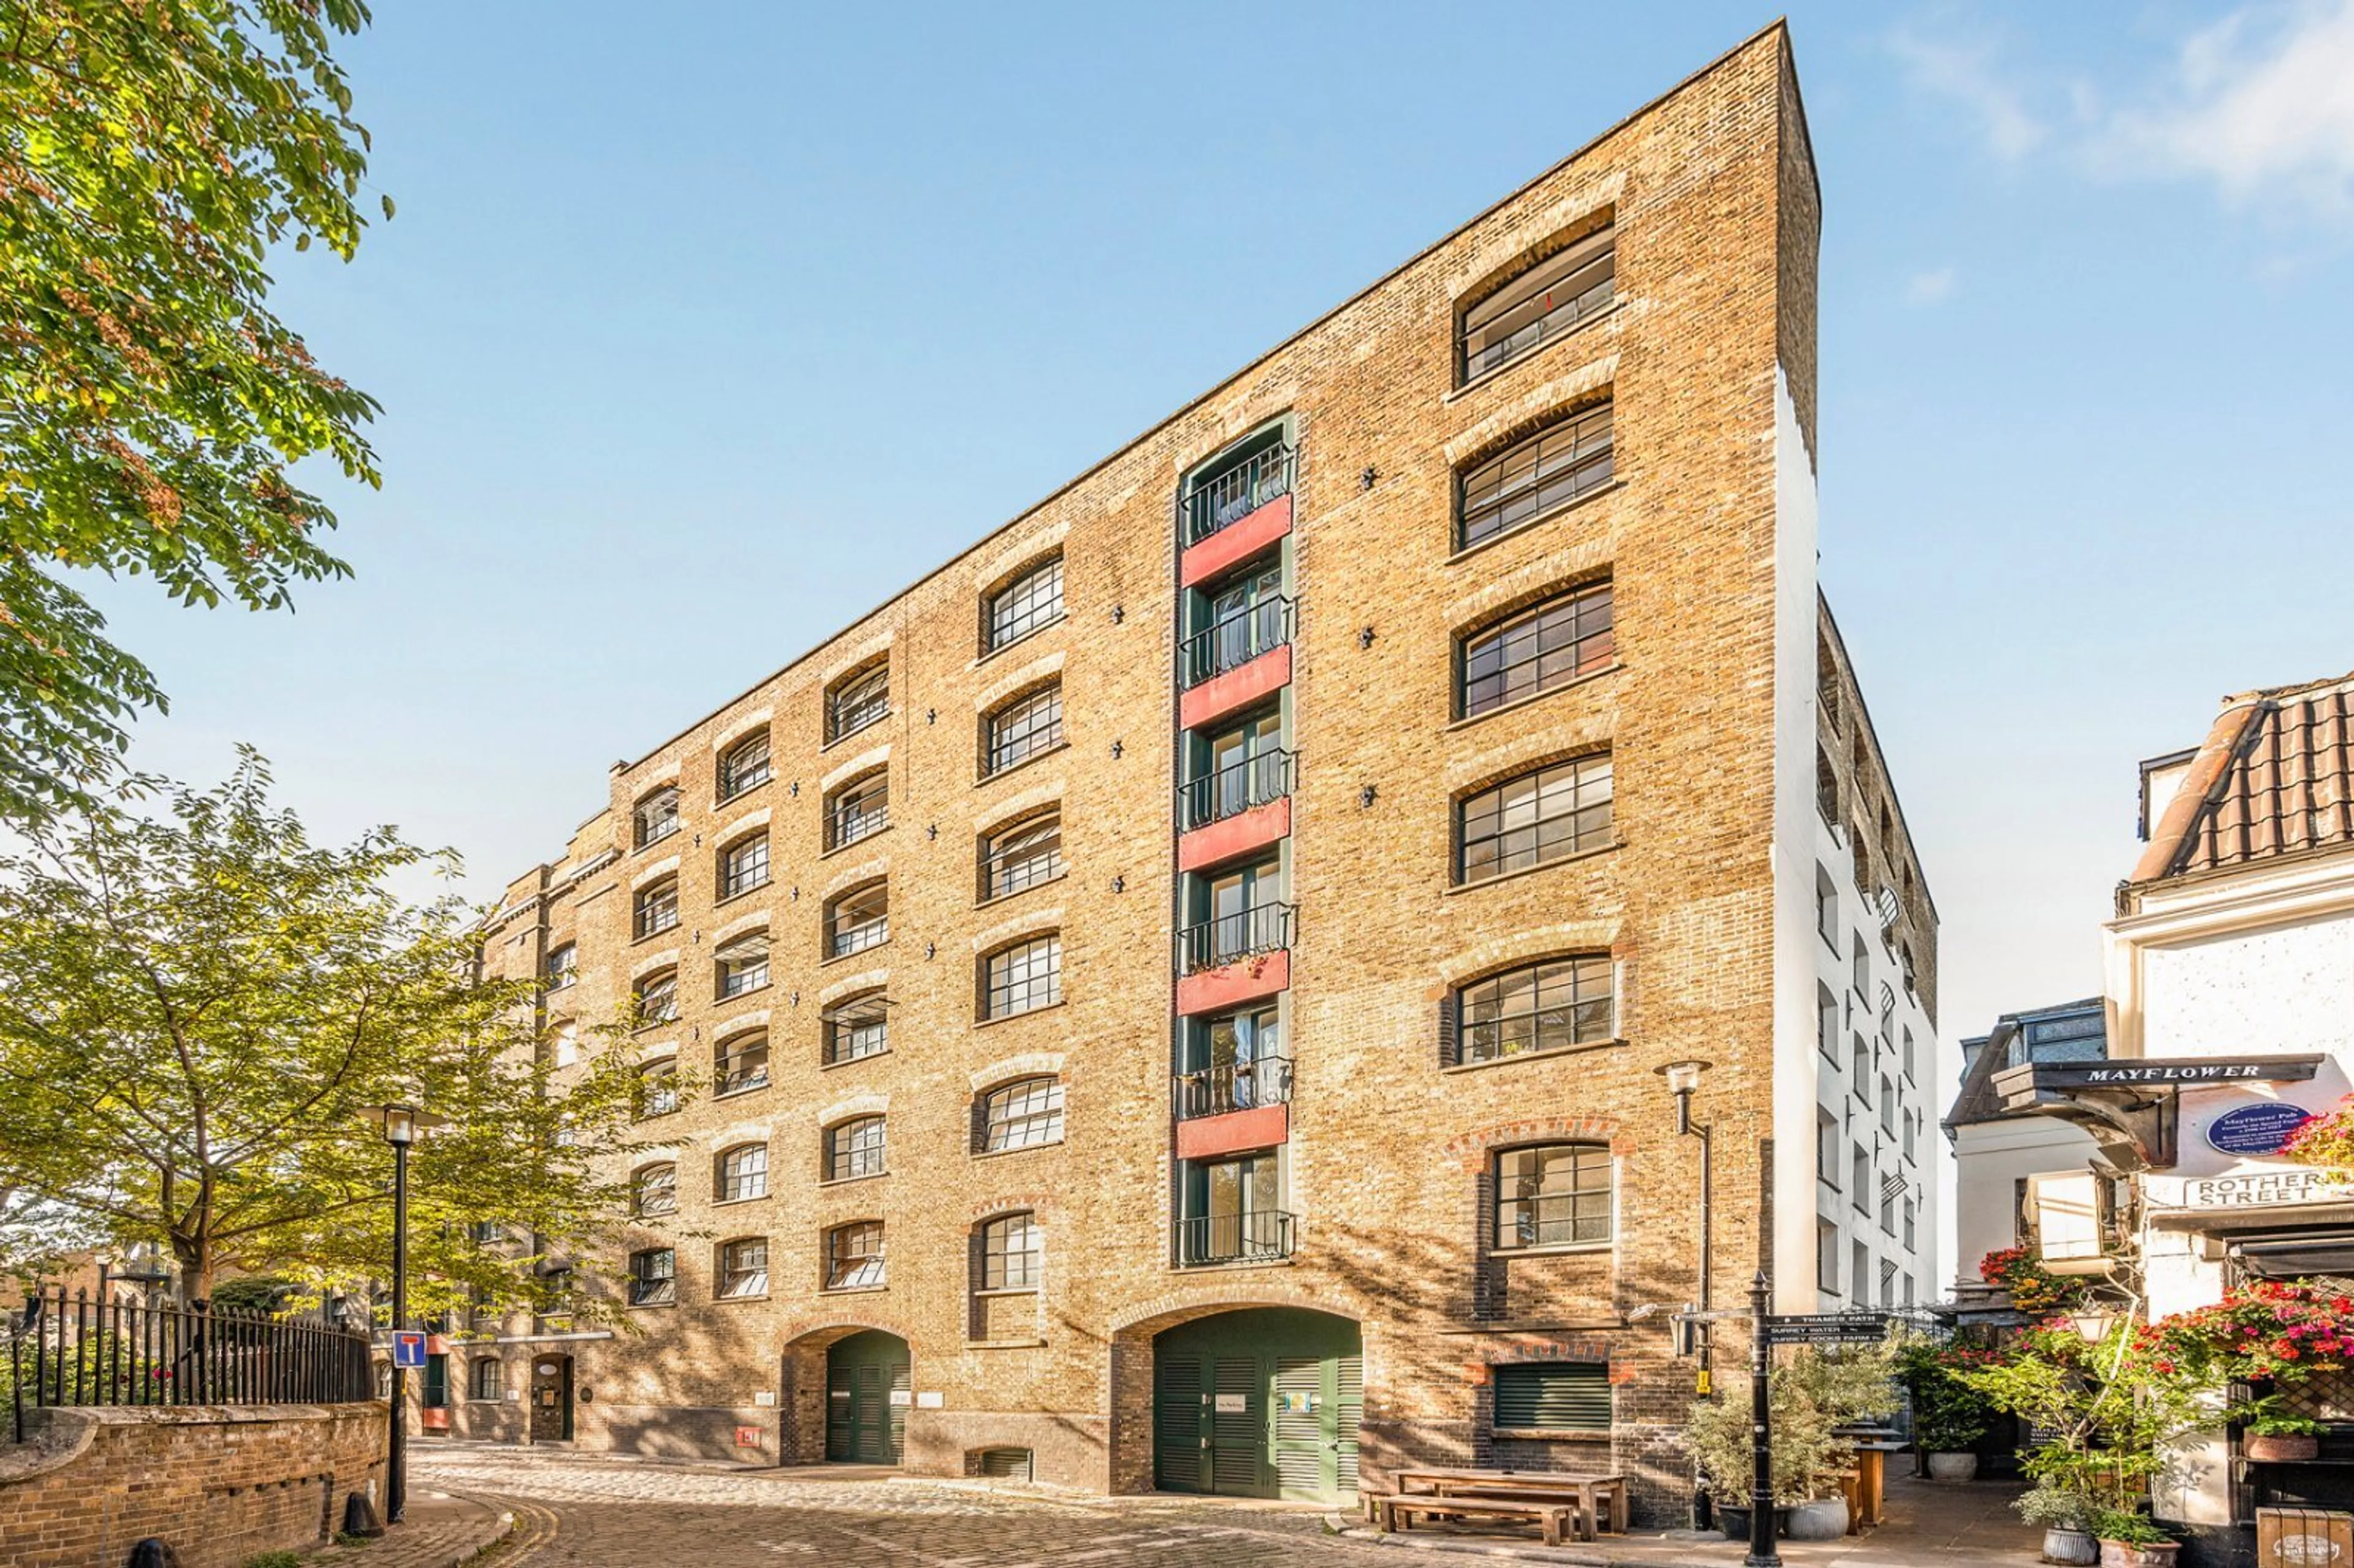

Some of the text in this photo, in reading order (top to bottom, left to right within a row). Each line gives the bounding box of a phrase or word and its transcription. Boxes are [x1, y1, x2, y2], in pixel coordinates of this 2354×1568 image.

[2087, 1065, 2259, 1081] MAYFLOWER
[2199, 1173, 2323, 1194] ROTHER
[2199, 1187, 2312, 1205] STREET
